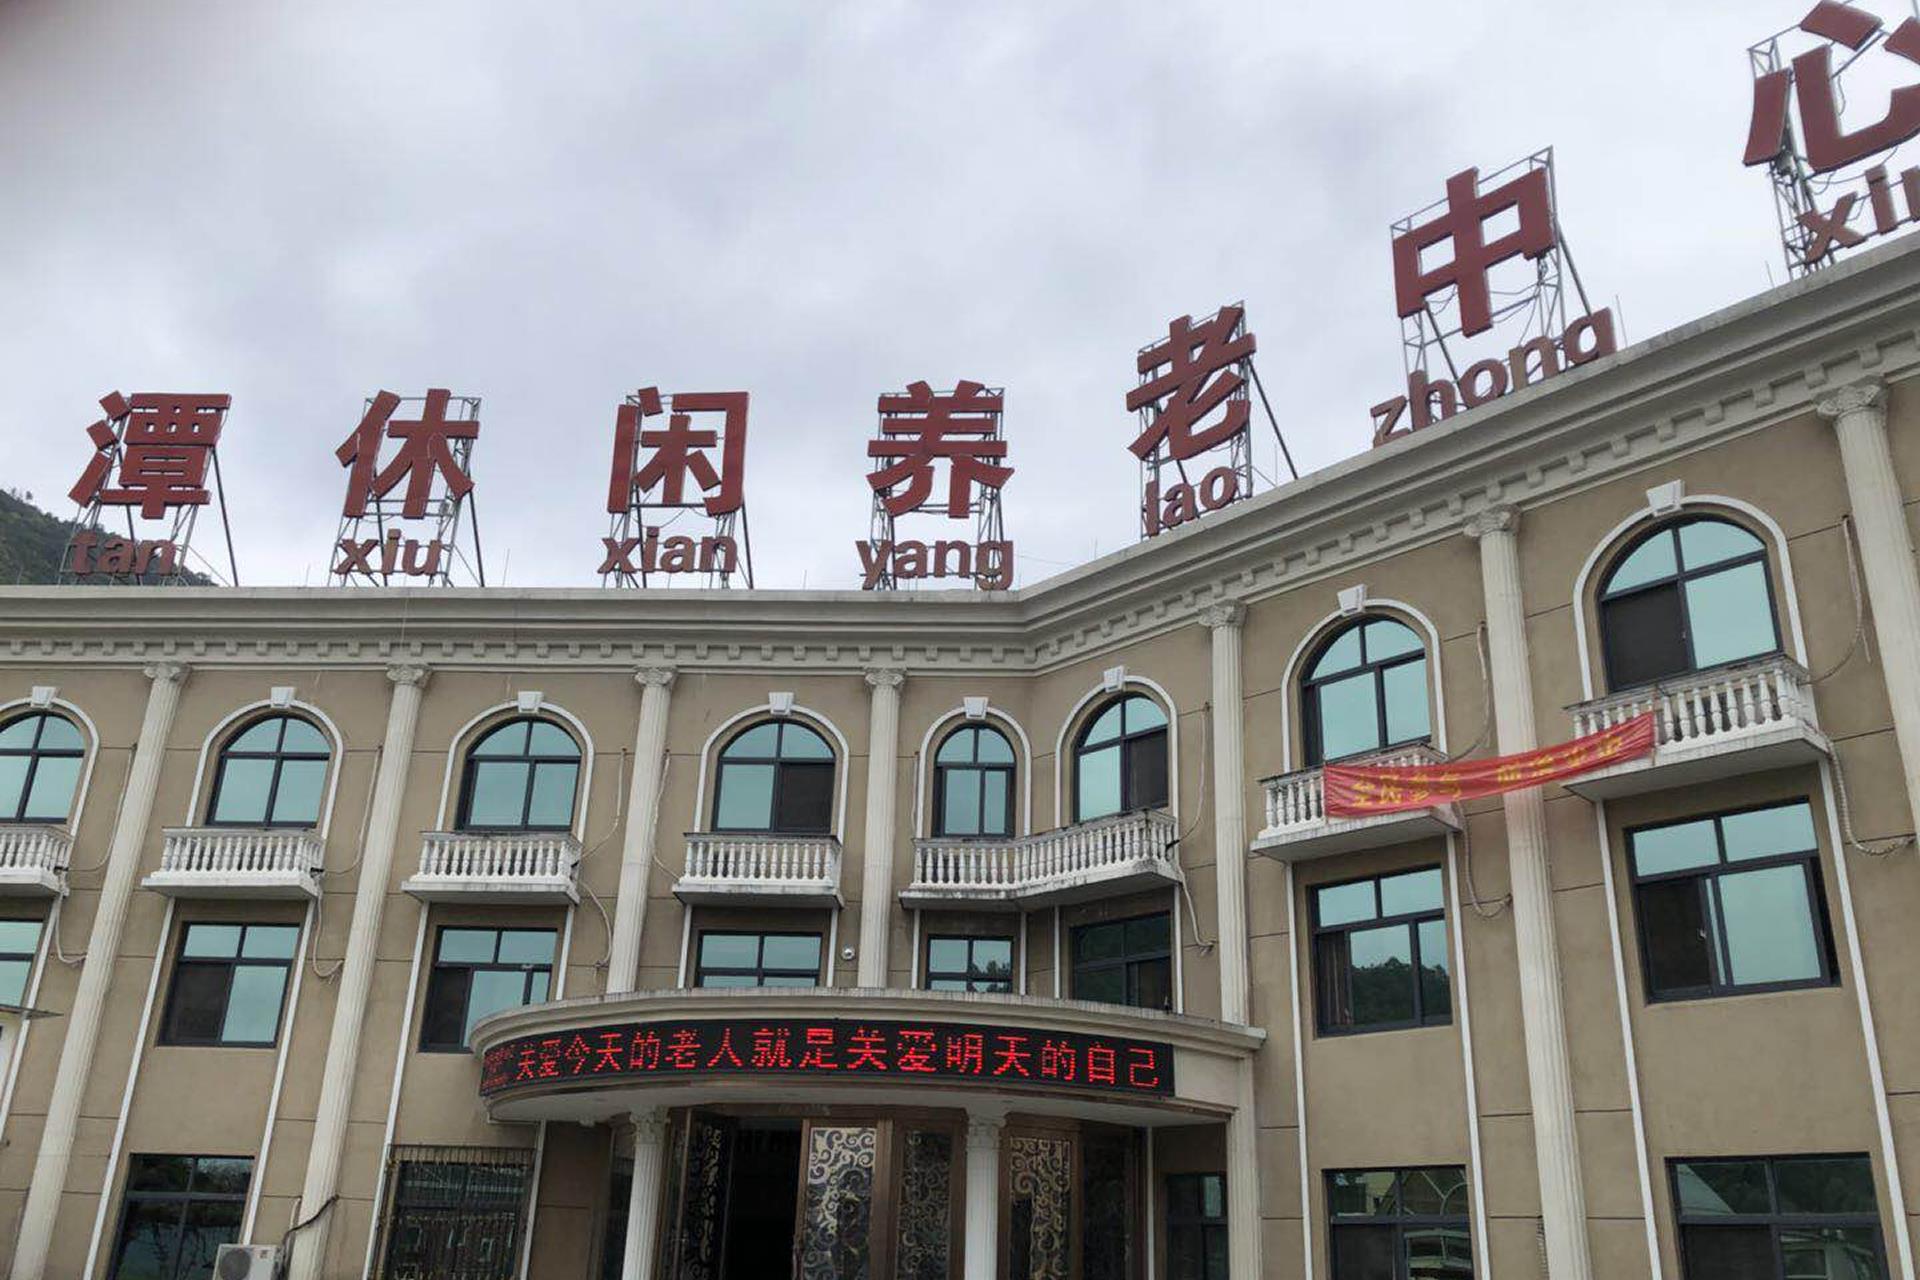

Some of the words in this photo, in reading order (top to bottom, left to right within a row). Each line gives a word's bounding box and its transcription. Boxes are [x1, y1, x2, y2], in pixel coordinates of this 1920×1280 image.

[69, 530, 178, 576] tan
[337, 528, 443, 576] xiu
[597, 526, 738, 574] xian
[856, 539, 1013, 590] yang
[1143, 466, 1238, 537] lao
[1371, 308, 1616, 447] zhong
[516, 1027, 1158, 1087] 关爱今天的老人就是关爱明天的自己
